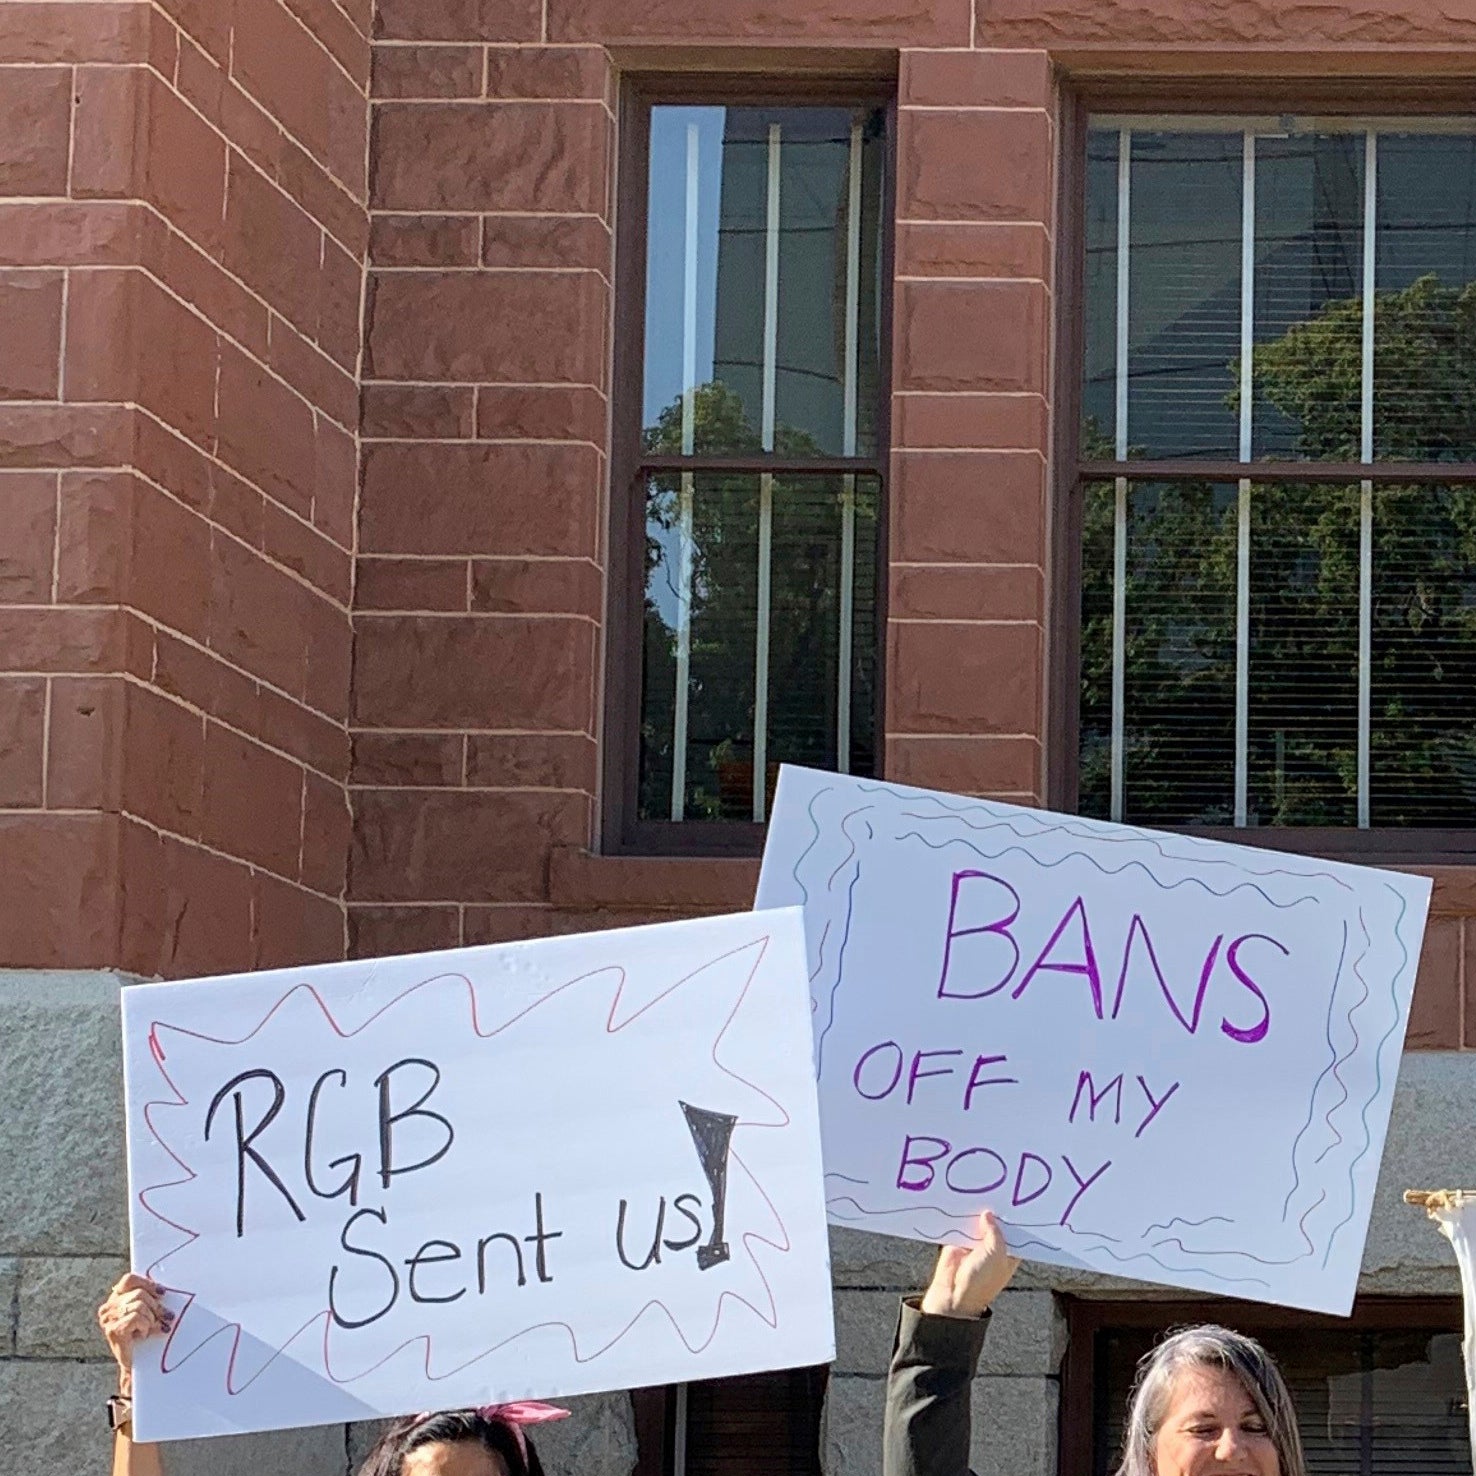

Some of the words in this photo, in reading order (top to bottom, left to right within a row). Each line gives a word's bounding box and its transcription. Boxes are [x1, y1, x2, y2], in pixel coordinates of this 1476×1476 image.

[938, 870, 1288, 1044] BANS
[205, 1058, 453, 1236] RGB
[854, 1041, 1017, 1110] OFF
[1069, 1071, 1179, 1137] MY
[897, 1135, 1111, 1225] BODY
[330, 1192, 562, 1328] Sent
